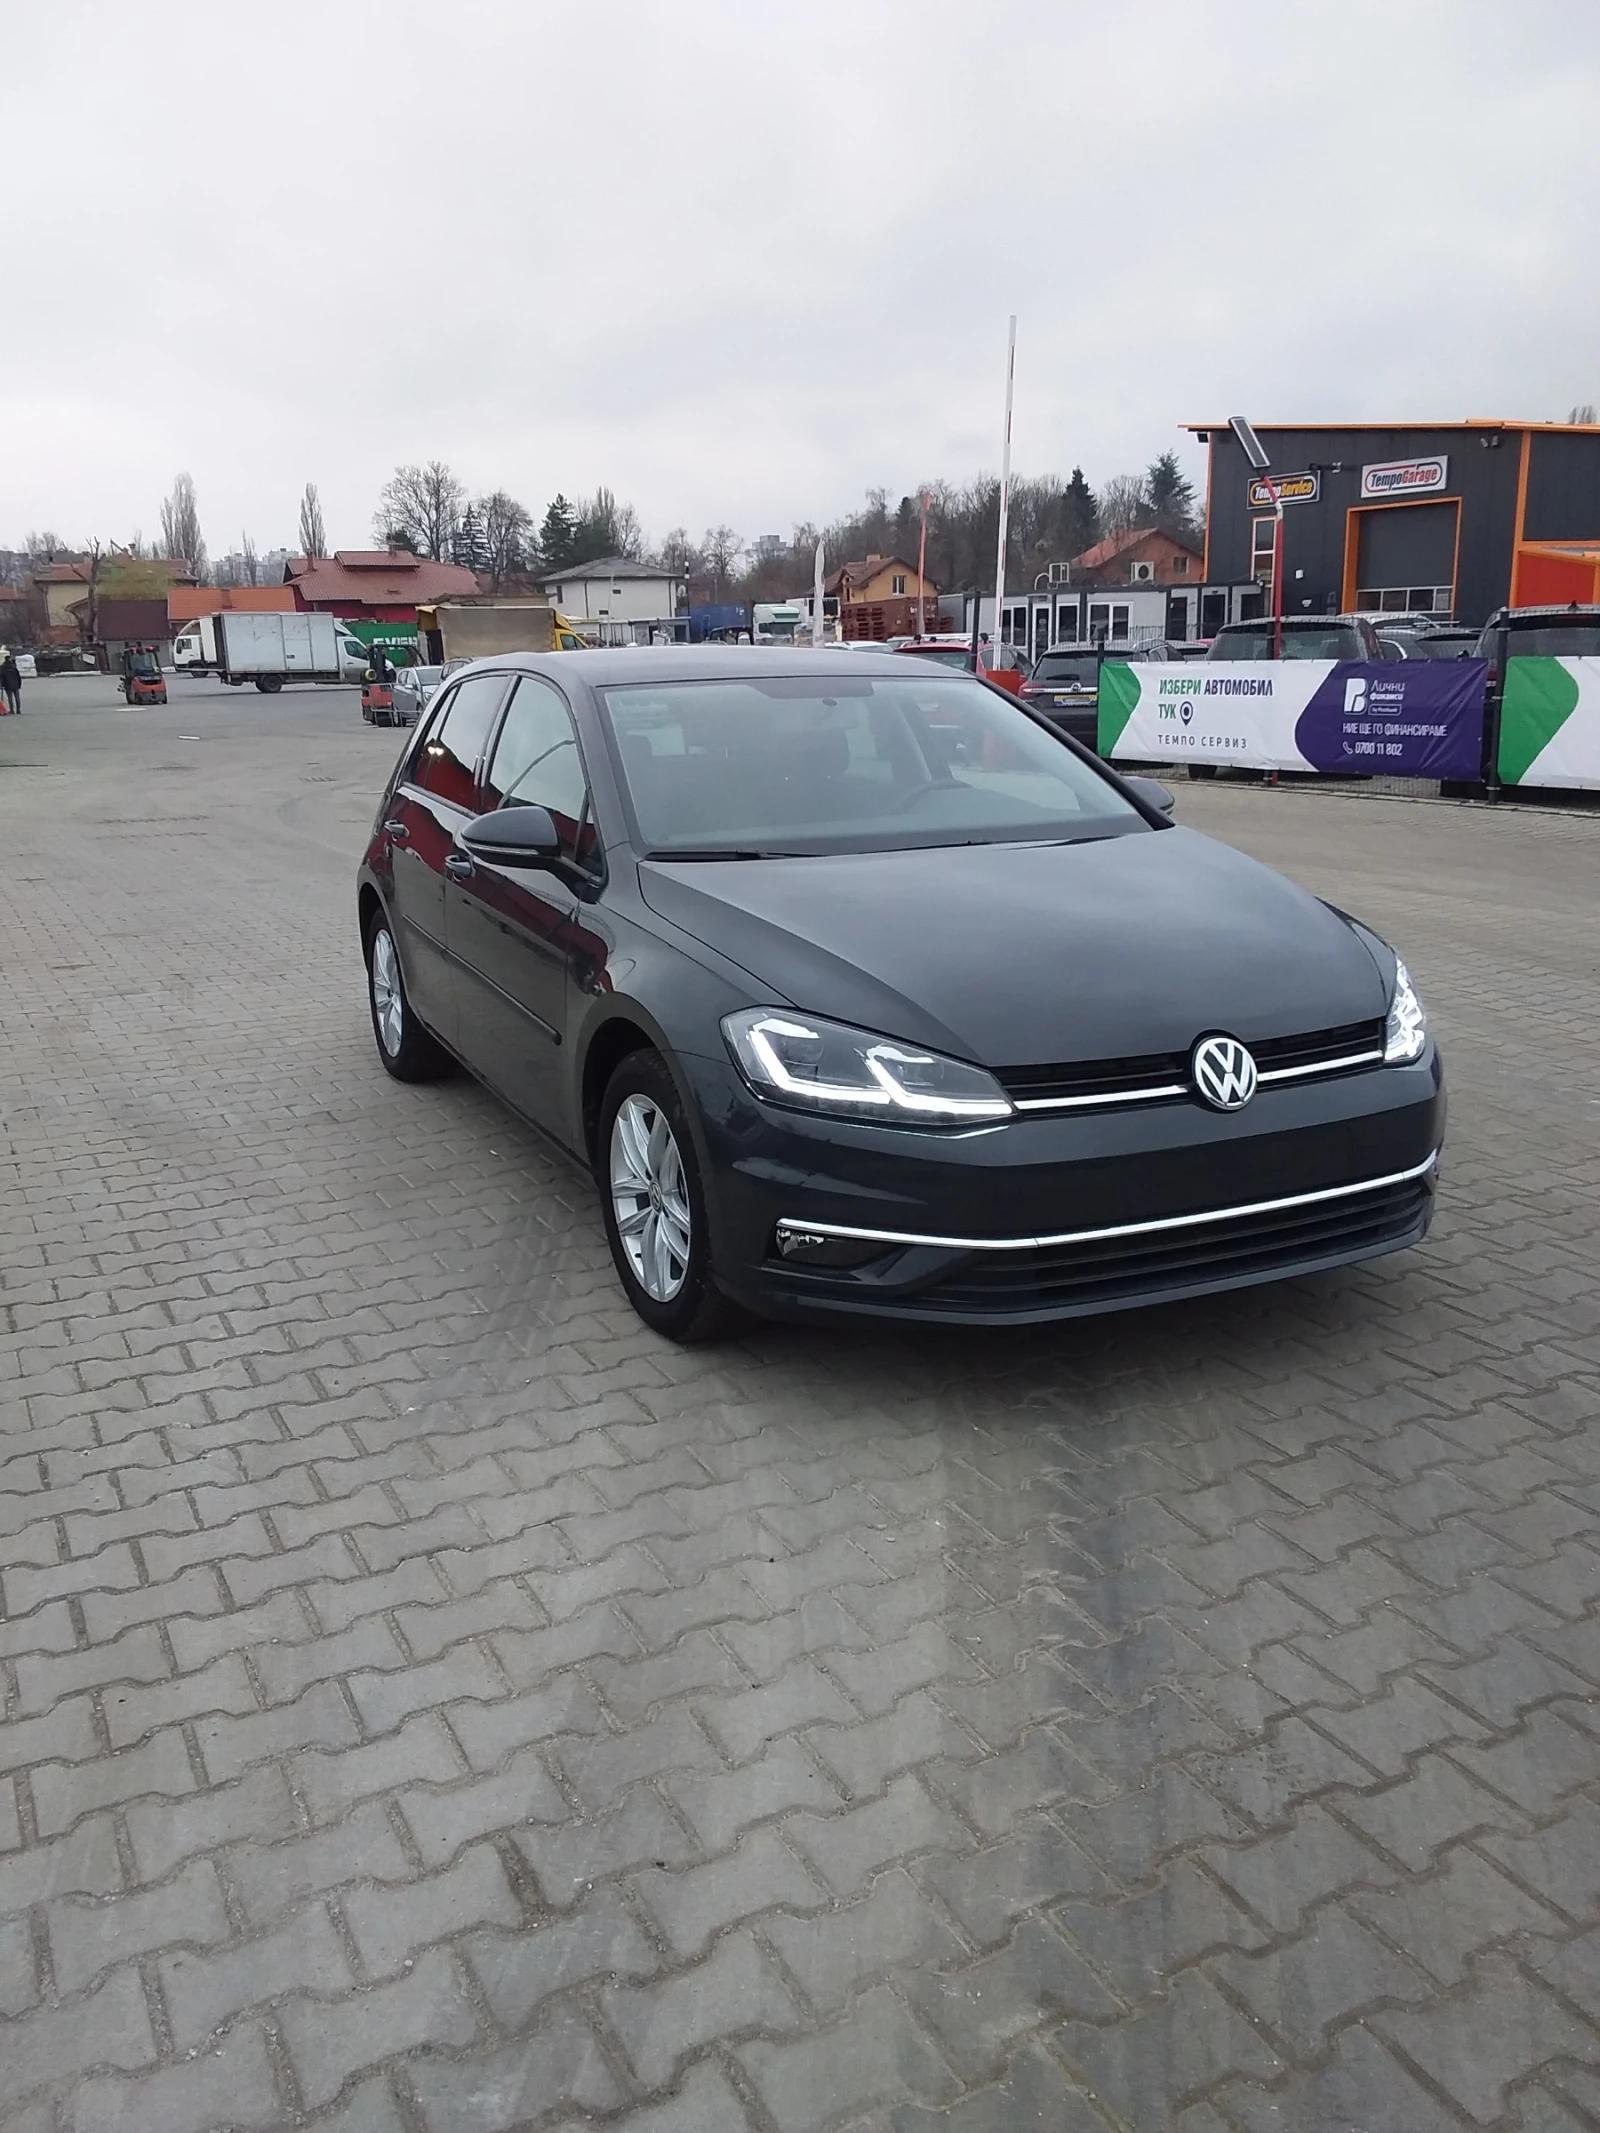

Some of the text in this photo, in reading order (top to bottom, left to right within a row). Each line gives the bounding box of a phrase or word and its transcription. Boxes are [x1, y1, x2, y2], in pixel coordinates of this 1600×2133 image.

[1371, 468, 1438, 491] TempoGarage
[1159, 679, 1274, 696] ИЗБЕРИ АВТОМОБИЛ
[1370, 679, 1405, 692] Лични
[1158, 704, 1177, 719] ТУК
[1343, 722, 1448, 737] НИЕ ЩЕ ГО ФИНАНСИРАМЕ
[1158, 734, 1247, 749] ТЕМПО СЕРВИЗ
[1355, 741, 1403, 756] 0700 11 802
